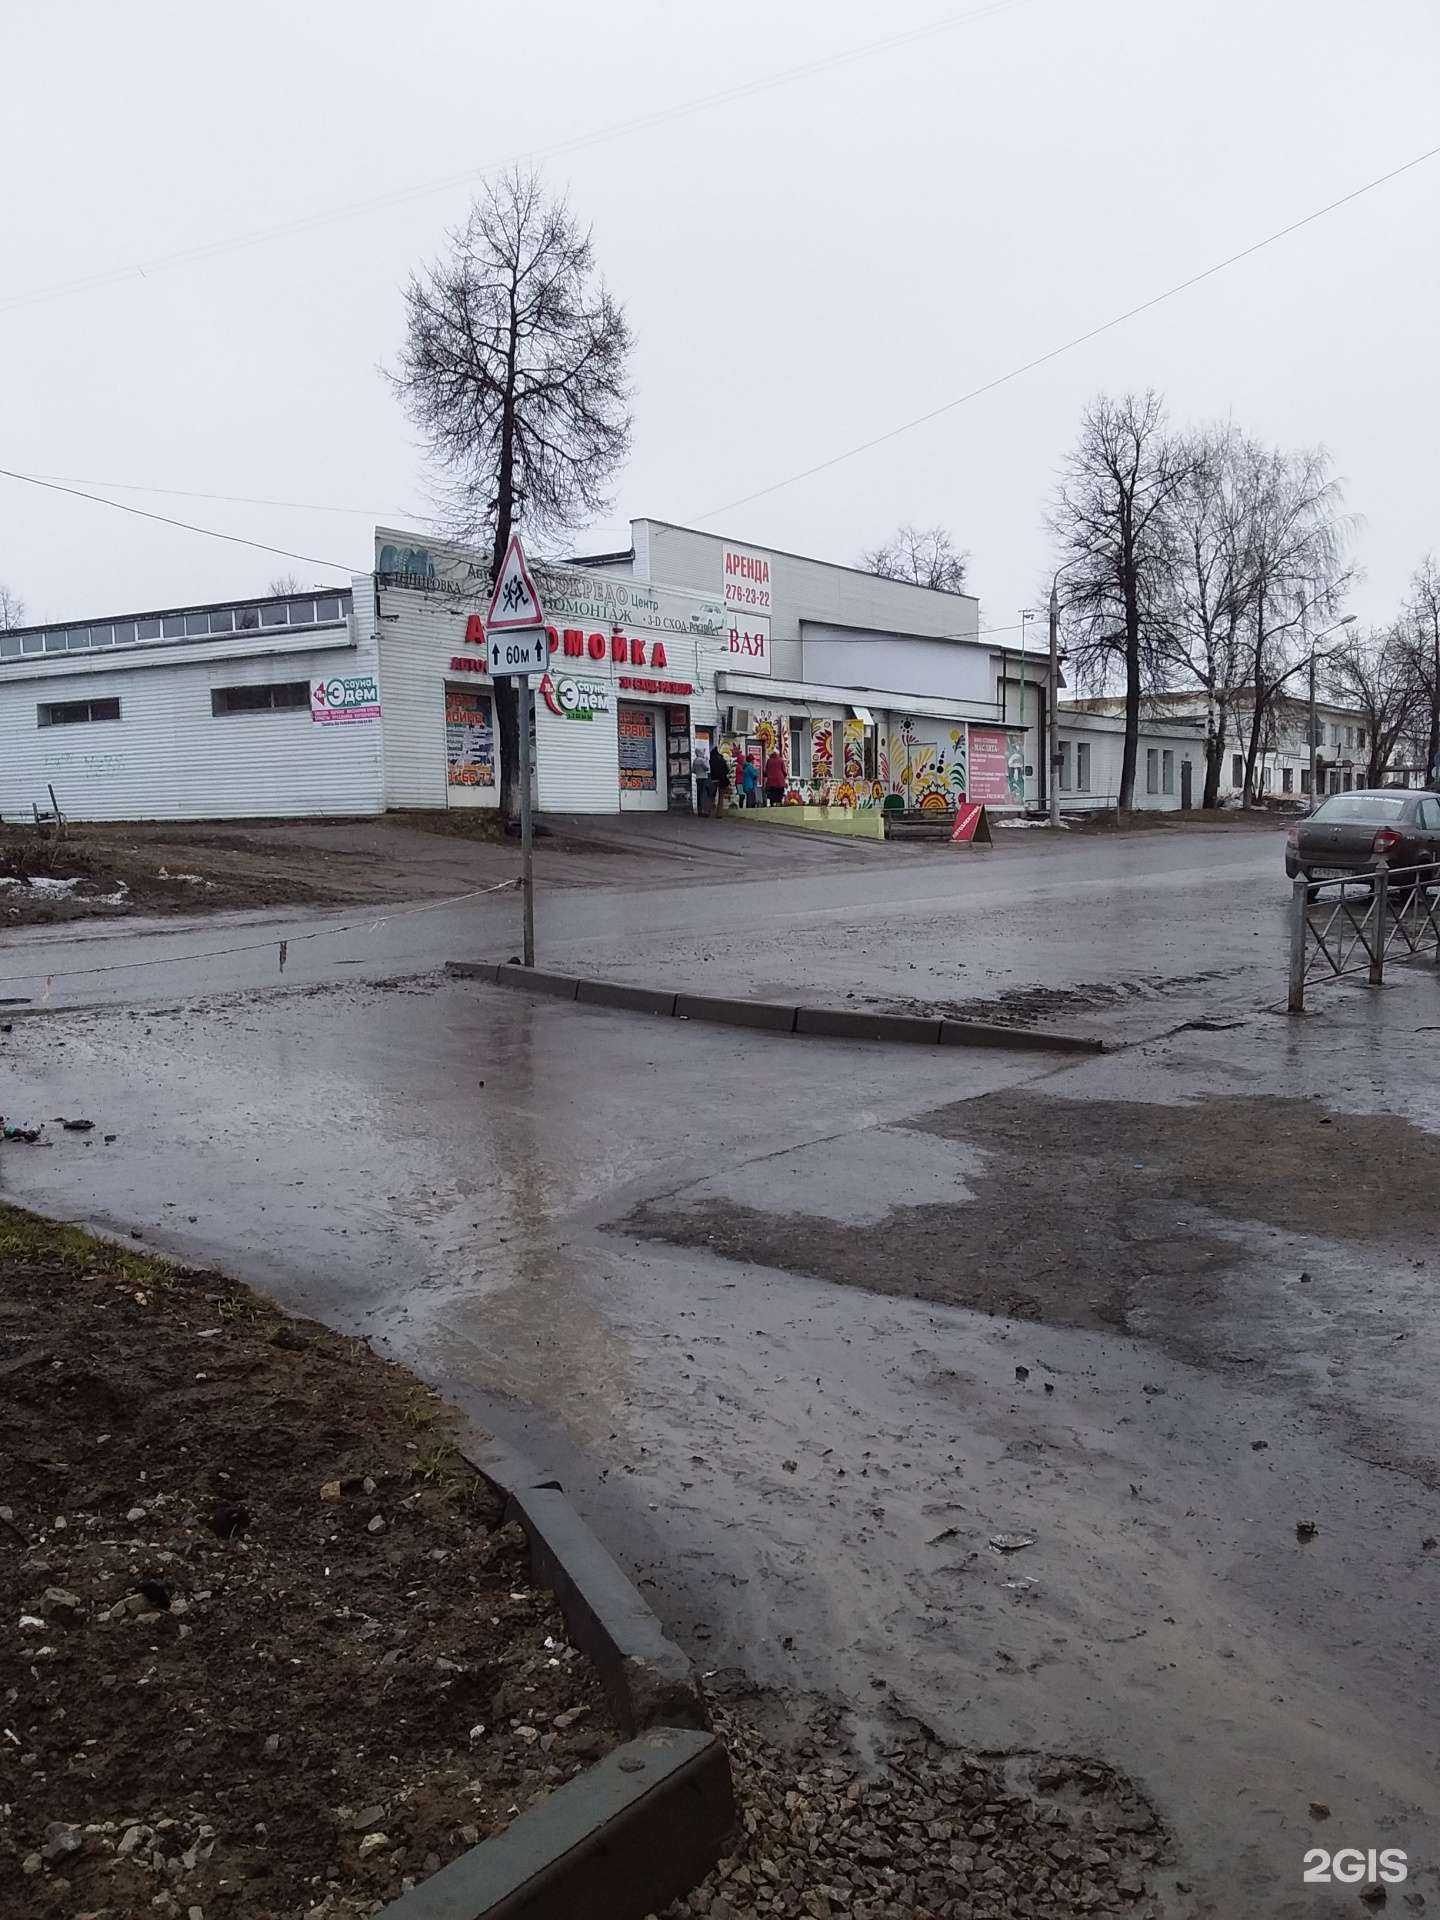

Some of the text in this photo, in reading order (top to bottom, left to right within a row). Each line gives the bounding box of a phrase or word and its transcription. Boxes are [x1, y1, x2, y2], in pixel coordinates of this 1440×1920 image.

[725, 552, 770, 585] АРЕНДА
[631, 593, 659, 613] Центр
[725, 583, 771, 608] 276-23-22
[728, 628, 765, 658] ВАЯ
[327, 680, 377, 707] Эдем
[344, 679, 372, 690] сауна
[559, 680, 609, 711] Эдем
[577, 682, 606, 695] сауна
